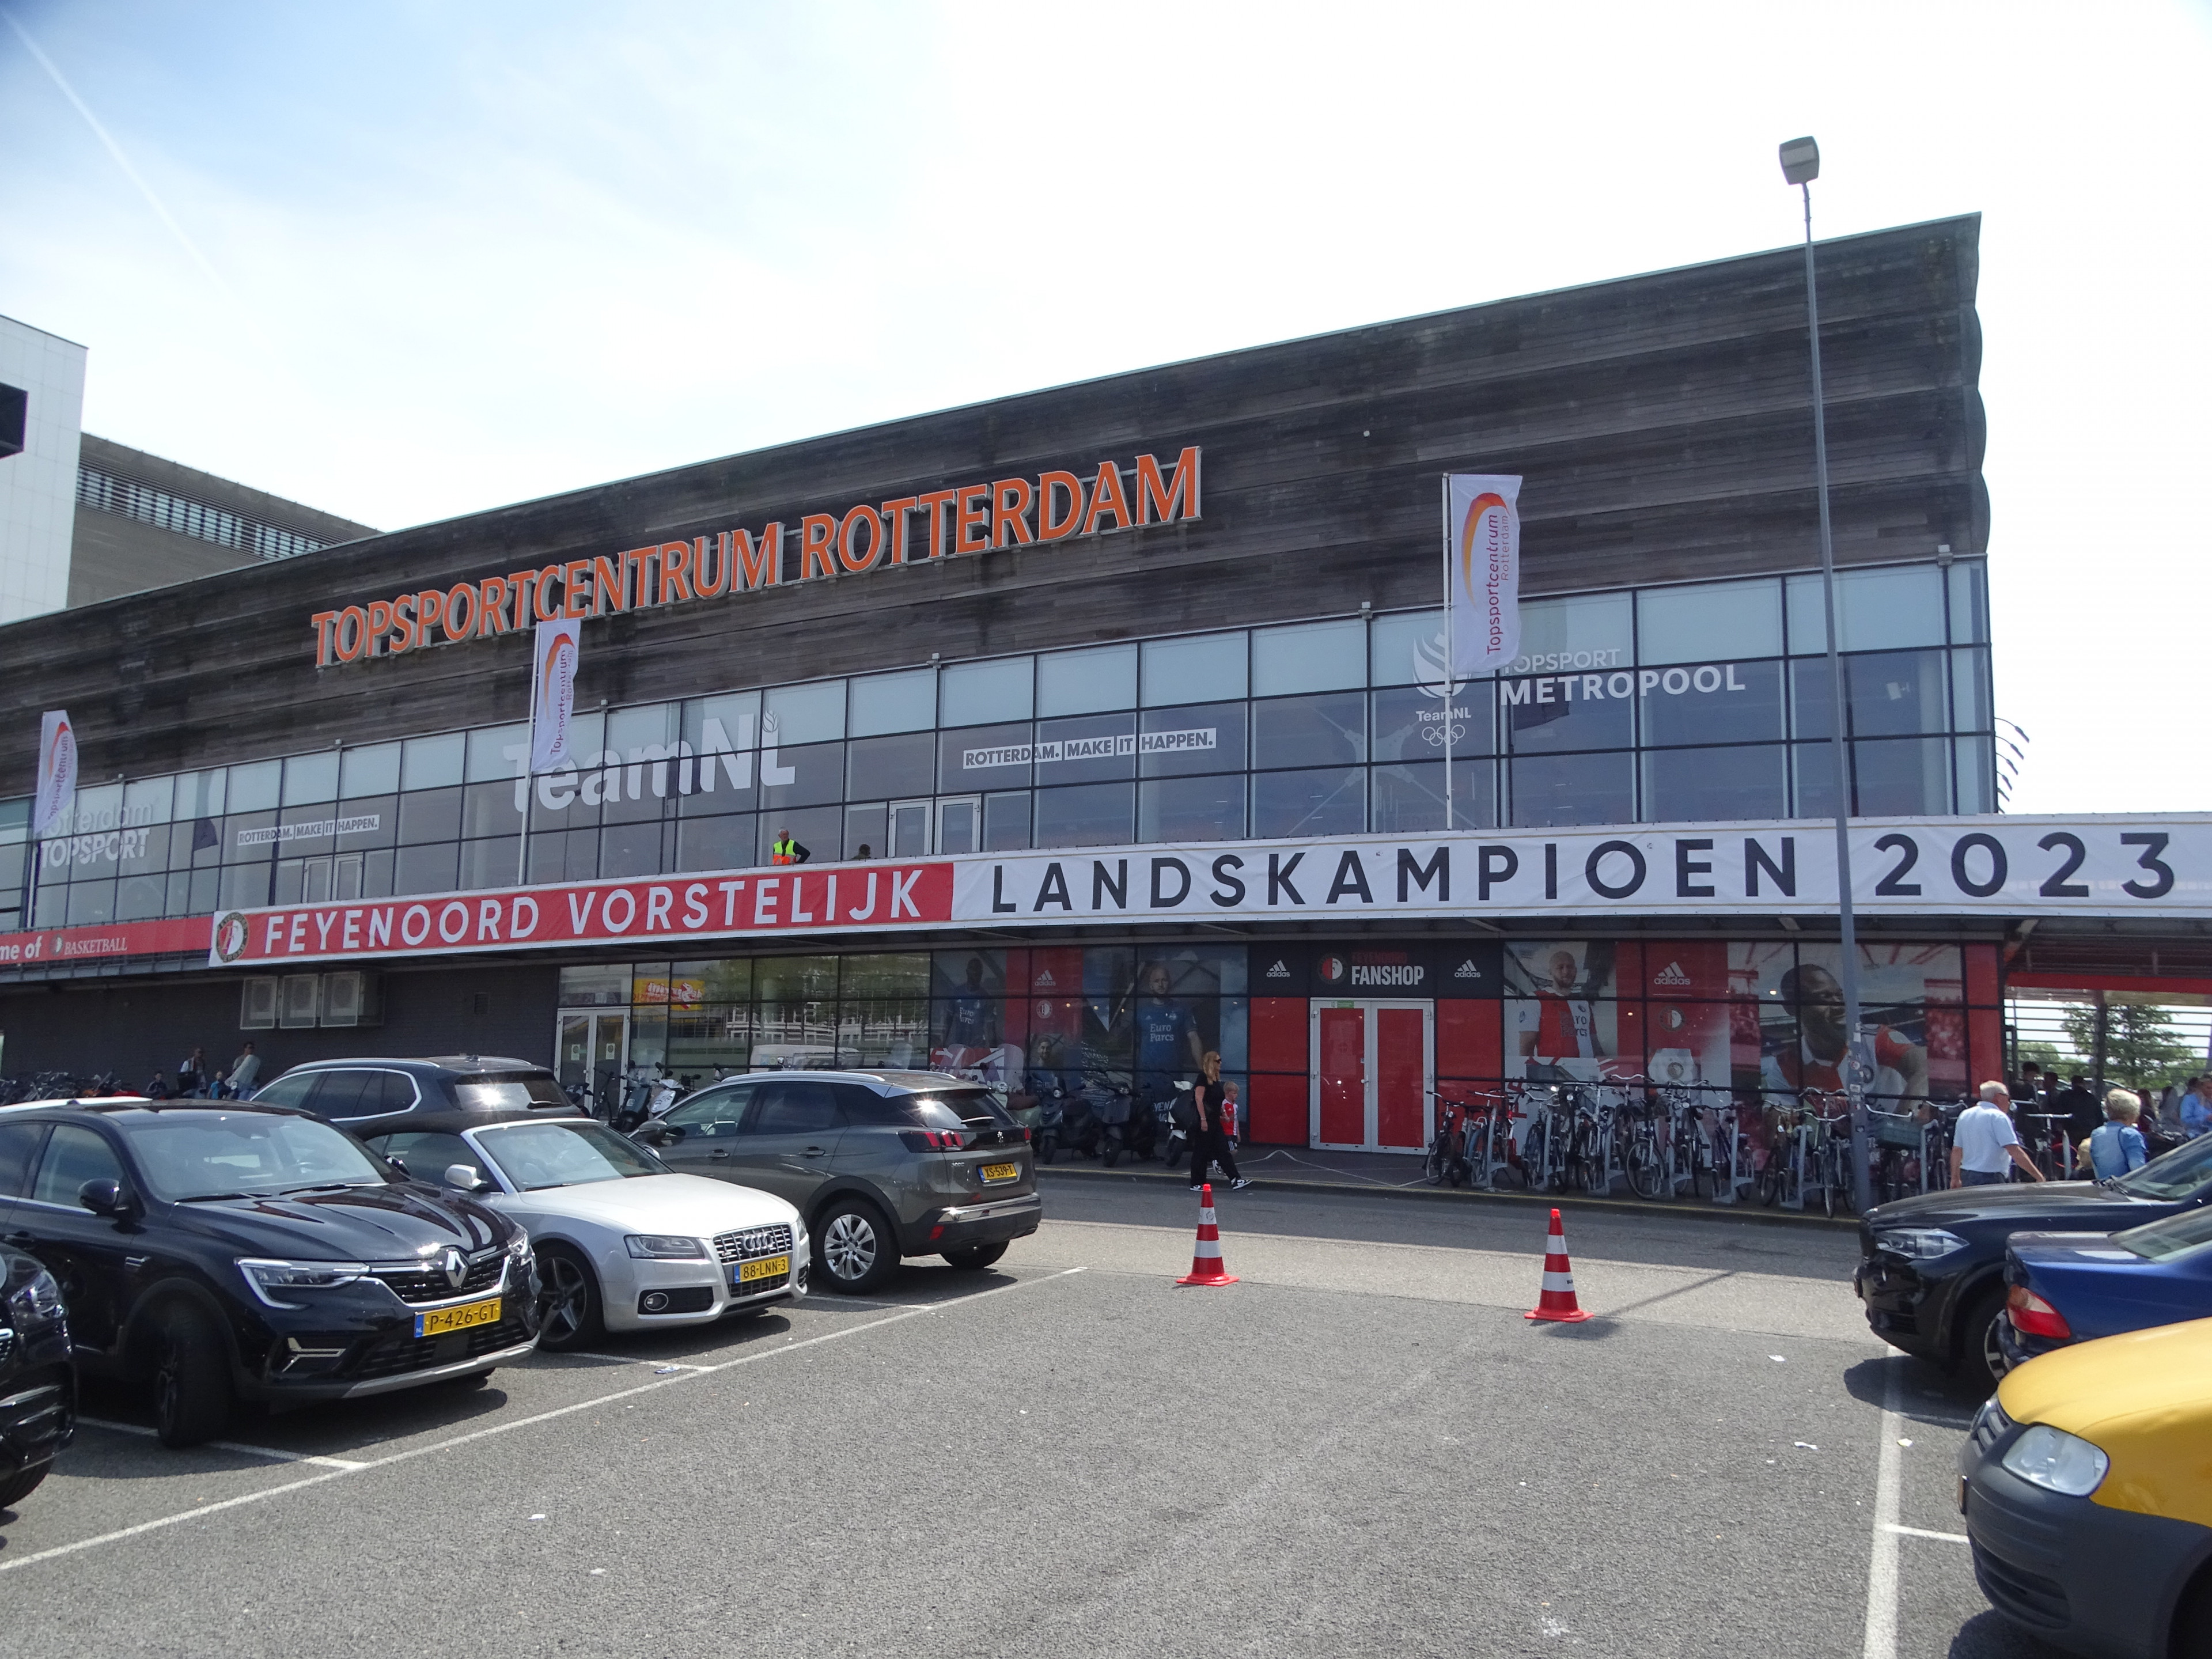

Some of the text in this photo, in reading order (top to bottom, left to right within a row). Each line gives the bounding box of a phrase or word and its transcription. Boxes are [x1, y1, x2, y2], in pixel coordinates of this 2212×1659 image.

[311, 445, 1202, 668] TOPSPORTCENTRUM ROTTERDAM
[1501, 516, 1509, 581] Rotterdam
[1486, 514, 1503, 655] Topsportcentrum
[1500, 664, 1745, 706] METROPOOL
[965, 732, 1213, 766] ROTTERDAM. MAKE IT HAPPEN.
[41, 804, 151, 836] otterdam
[238, 818, 378, 844] ROTTERDAM. MAKE IT HAPPEN.
[40, 828, 151, 868] TOPSPORT
[264, 832, 2174, 954] FEYENOORD VORSTELIJK LANDSKAMPIOEN 2023
[24, 935, 43, 959] of
[65, 937, 127, 956] BASKETBALL
[1351, 965, 1424, 986] FANSHOP
[1654, 976, 1691, 986] adidas
[1150, 1024, 1172, 1033] Euro
[1150, 1033, 1175, 1042] Parcs
[984, 1165, 1014, 1178] XS-539-T
[743, 1259, 786, 1278] 88-LNN-3
[430, 1303, 497, 1331] P-426-GT
